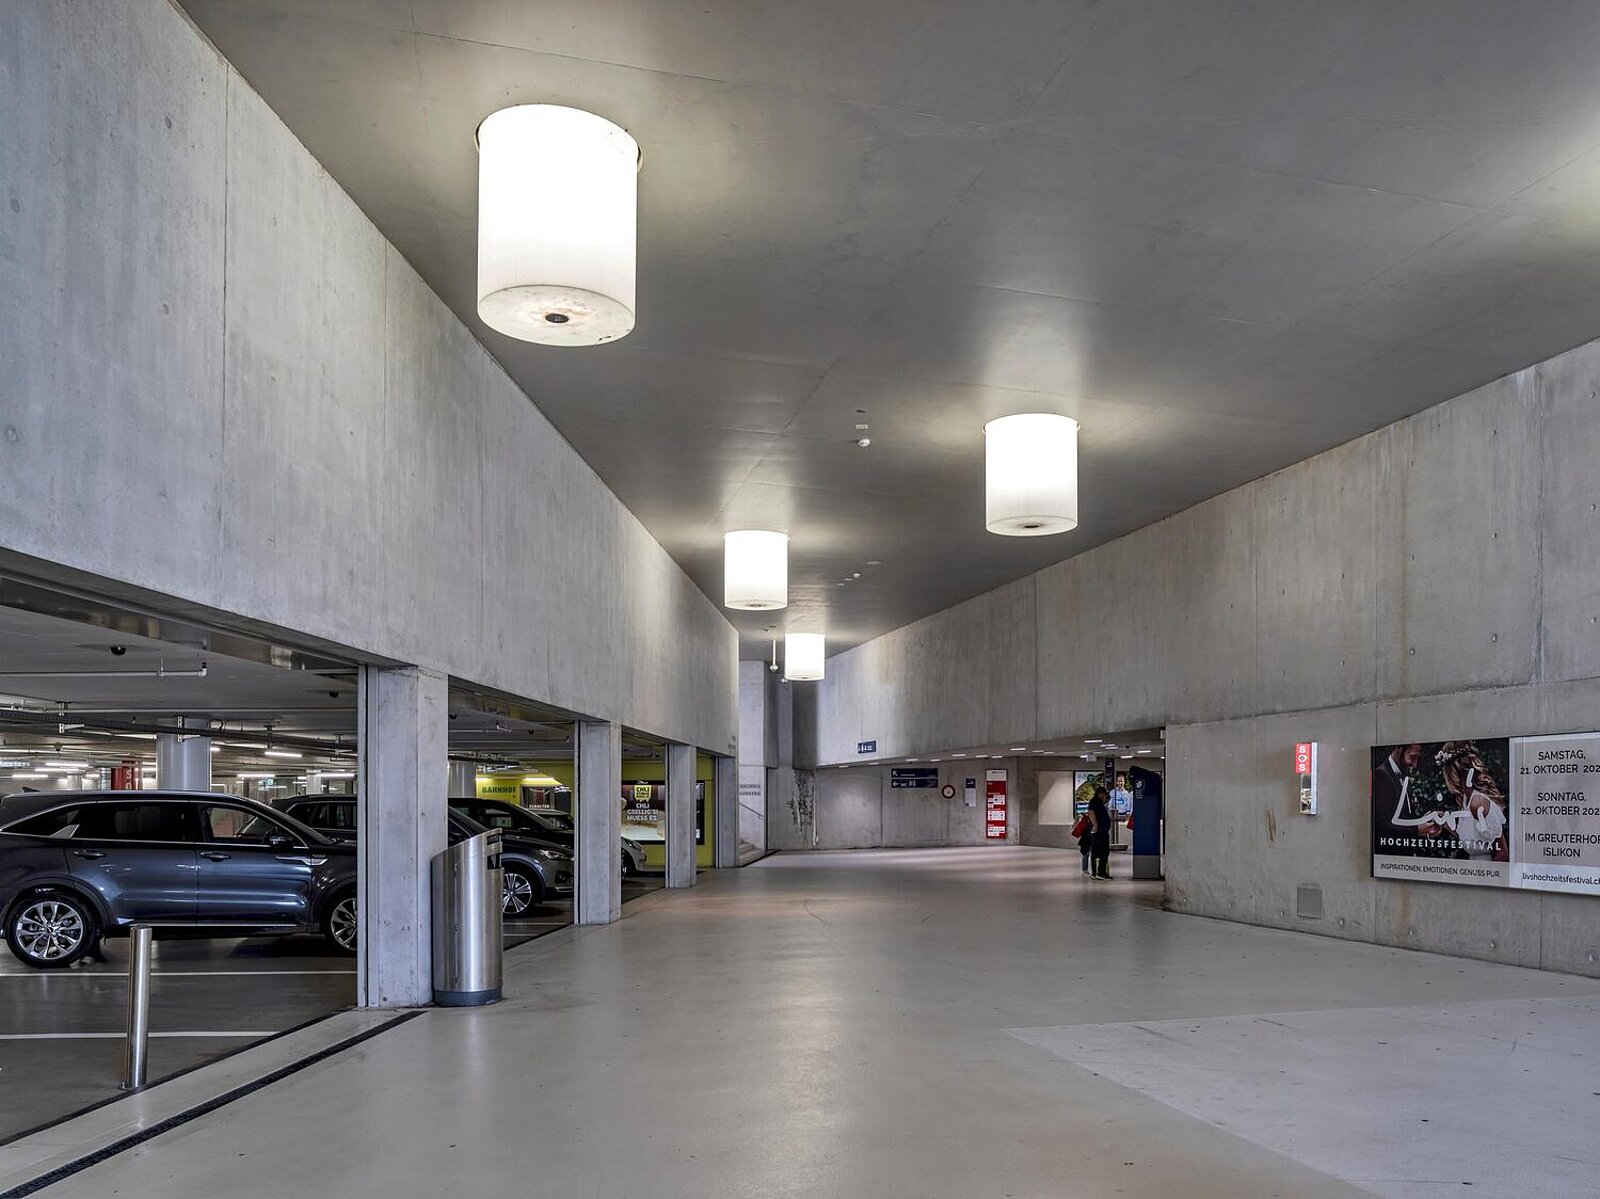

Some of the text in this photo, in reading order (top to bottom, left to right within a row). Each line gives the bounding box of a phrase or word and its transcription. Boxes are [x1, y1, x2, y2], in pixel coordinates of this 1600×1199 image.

[1298, 745, 1308, 772] SOS
[1538, 749, 1586, 761] SAMSTAG,
[1533, 764, 1579, 774] OKTOBER
[1537, 792, 1587, 802] SONNTAG,
[1534, 806, 1581, 815] OKTOBER
[1525, 833, 1536, 842] IM
[1380, 837, 1502, 851] HOCHZEITSFESTIVAL
[1543, 846, 1581, 857] ISLIKON
[1460, 868, 1485, 877] GENUSS
